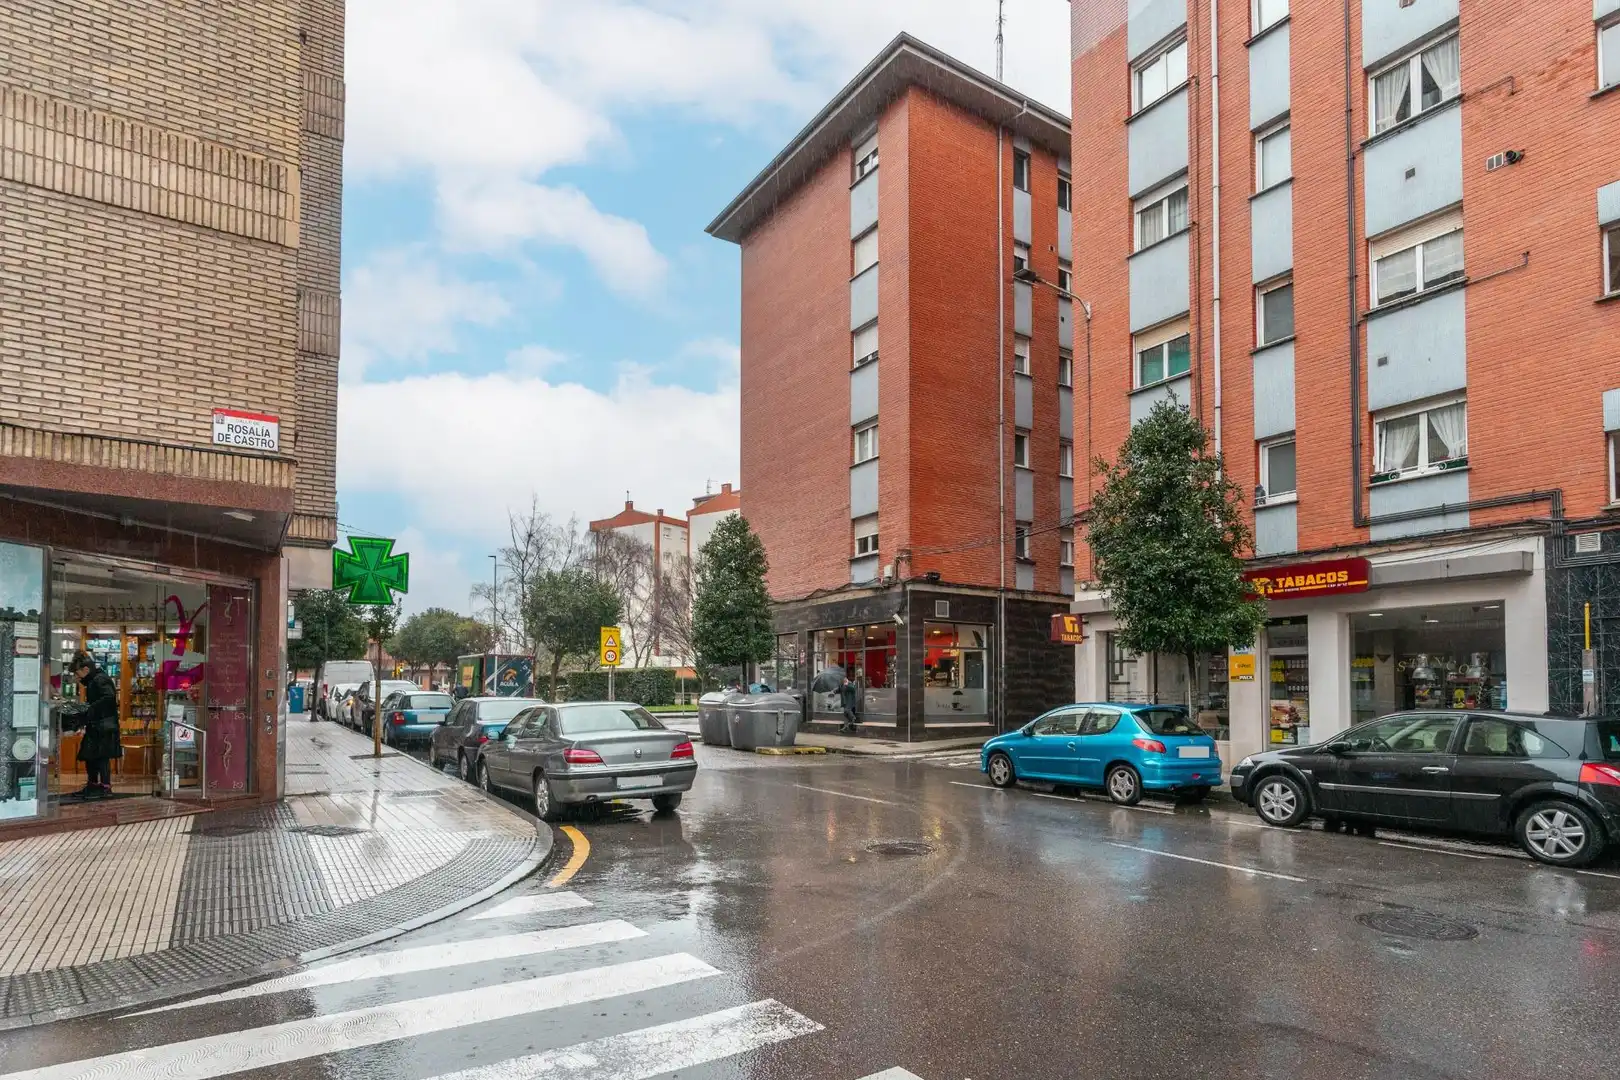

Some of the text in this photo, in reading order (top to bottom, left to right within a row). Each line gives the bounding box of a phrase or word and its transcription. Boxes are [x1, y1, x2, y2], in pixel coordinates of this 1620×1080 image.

[227, 423, 270, 437] ROSALÍA
[217, 433, 275, 448] DE CASTRO
[1275, 570, 1349, 588] TABACOS
